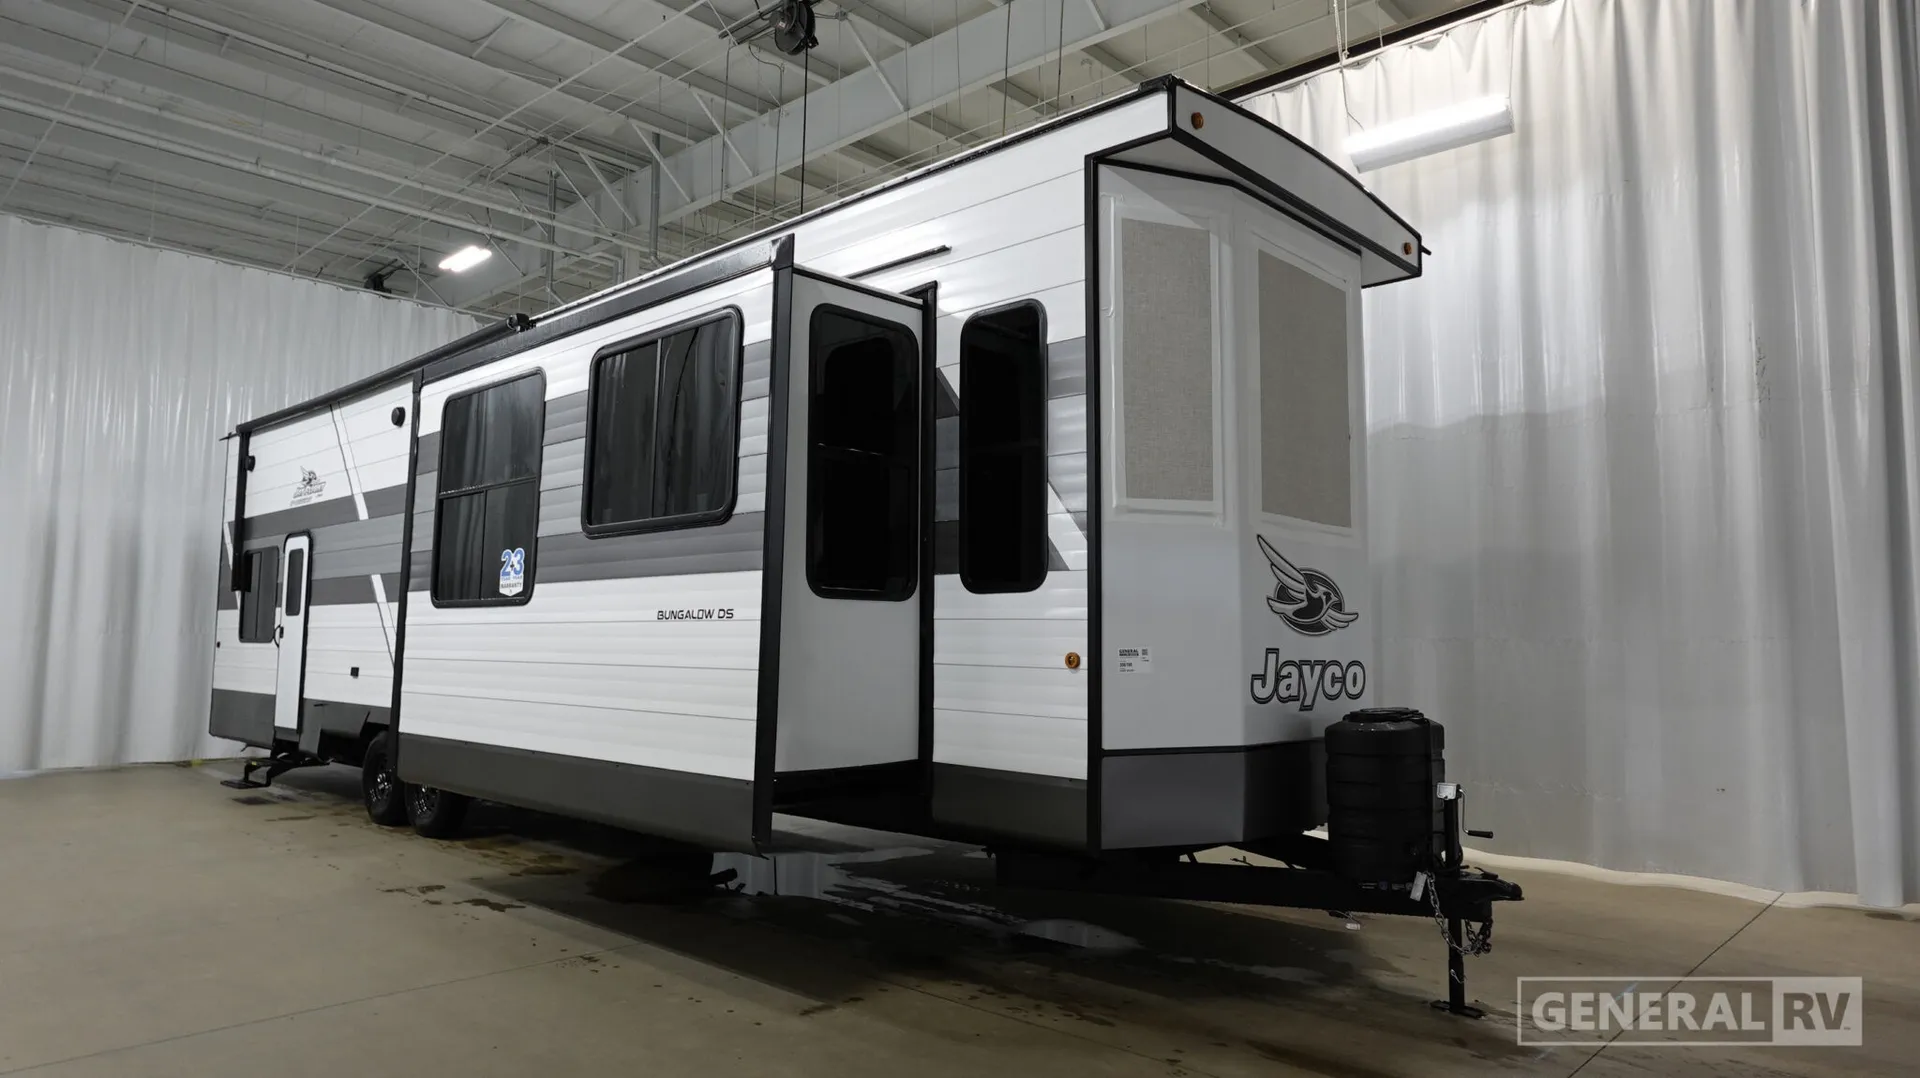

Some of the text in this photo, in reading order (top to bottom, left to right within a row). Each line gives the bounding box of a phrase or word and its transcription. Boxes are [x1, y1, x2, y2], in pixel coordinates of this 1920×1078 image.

[657, 608, 734, 620] BUNGALOW DS
[1251, 647, 1366, 711] Jayco
